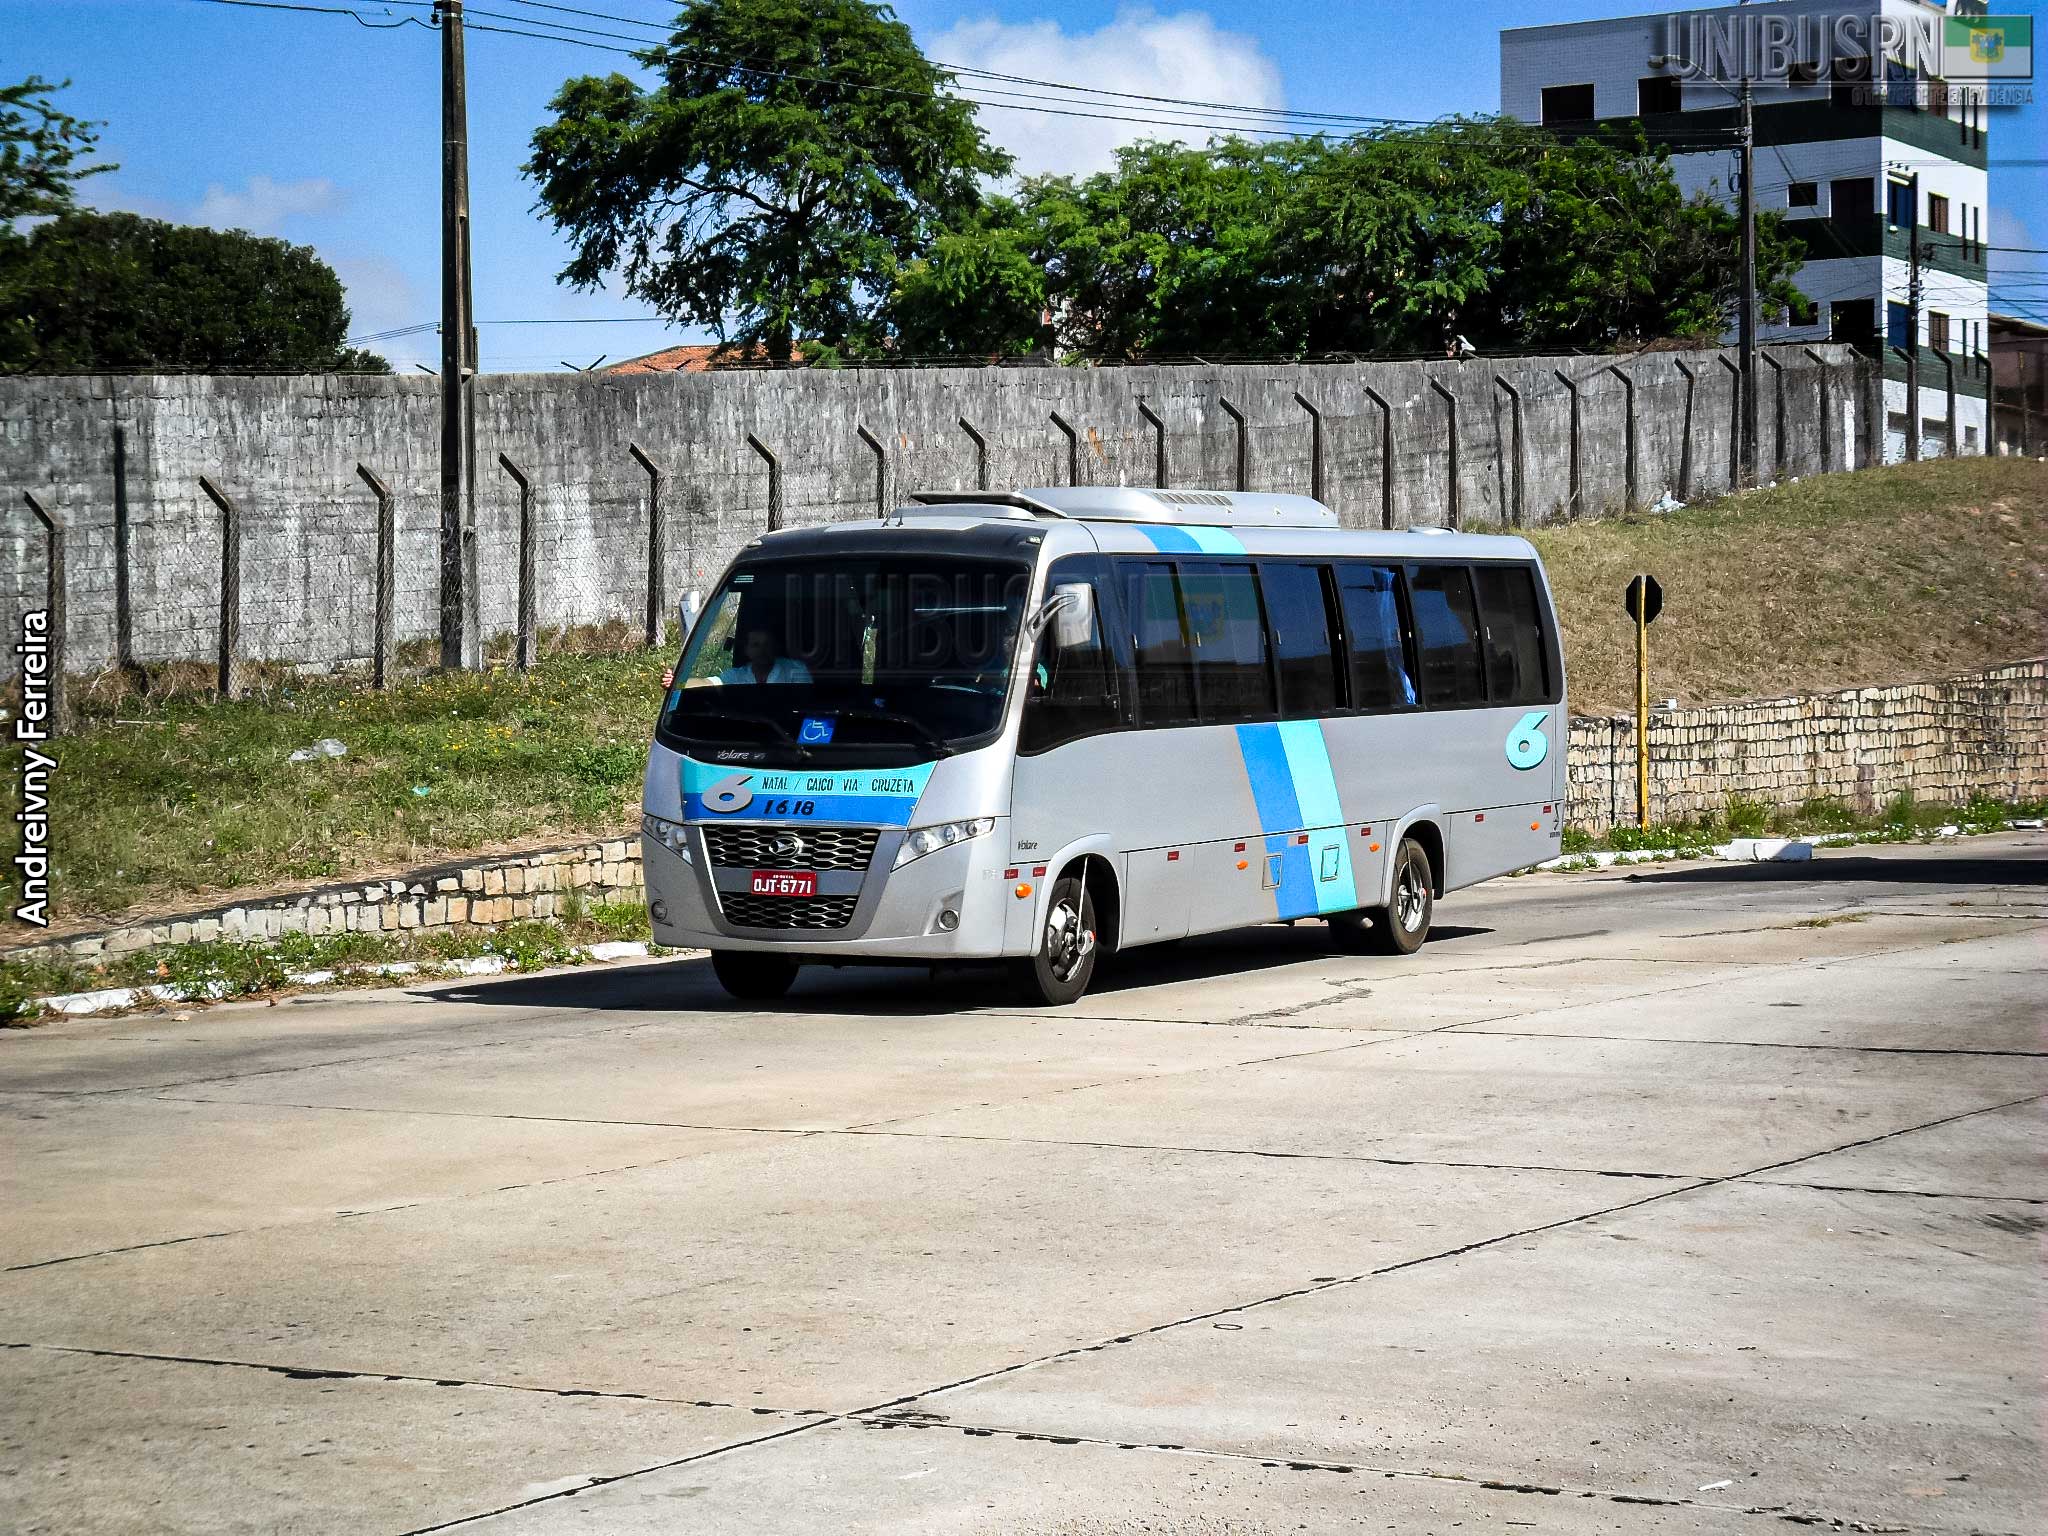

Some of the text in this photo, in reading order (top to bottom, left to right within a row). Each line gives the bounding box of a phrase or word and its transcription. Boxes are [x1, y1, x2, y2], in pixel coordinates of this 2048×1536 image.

[717, 750, 750, 759] Volare
[762, 776, 788, 790] NATAL
[843, 778, 859, 792] VIA
[871, 778, 914, 793] CRUZETA
[1018, 840, 1038, 850] Volare
[753, 878, 812, 894] OJT-6771
